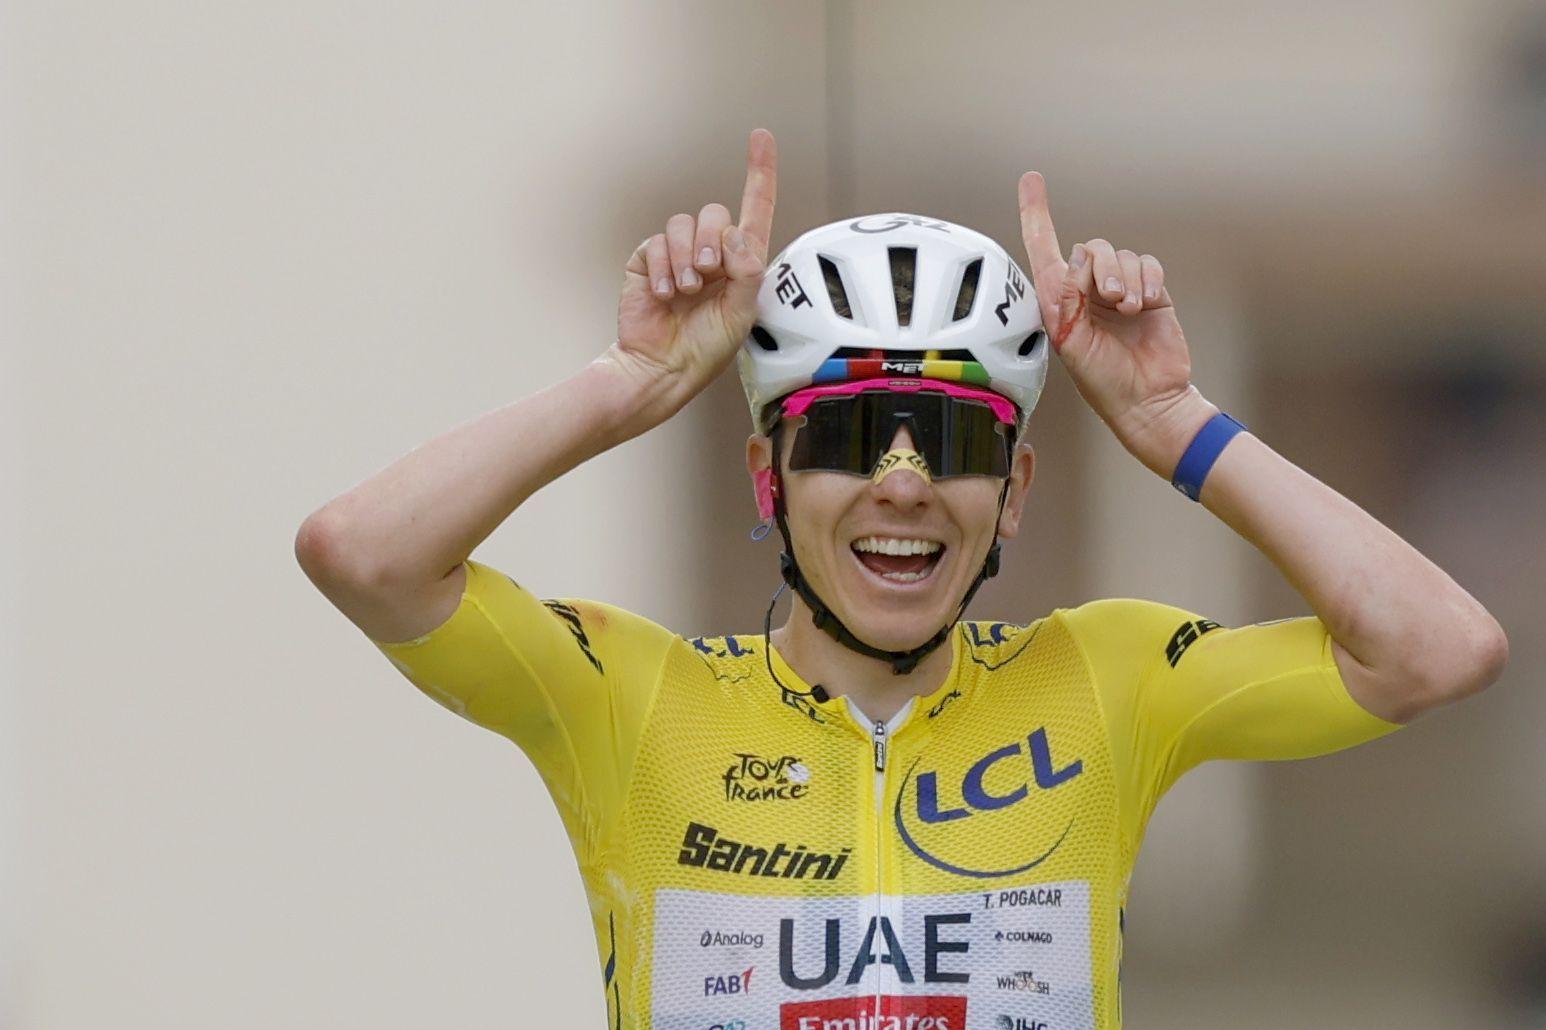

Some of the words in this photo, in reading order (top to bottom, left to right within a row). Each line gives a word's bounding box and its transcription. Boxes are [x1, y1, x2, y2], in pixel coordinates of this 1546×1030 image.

[881, 362, 925, 374] MET
[916, 727, 1084, 824] LCL
[677, 822, 852, 881] Santini
[983, 893, 995, 909] T.
[1000, 889, 1062, 908] POGACAR
[713, 931, 765, 949] Analog
[1006, 931, 1053, 944] COLNAGO
[779, 912, 973, 991] UAE
